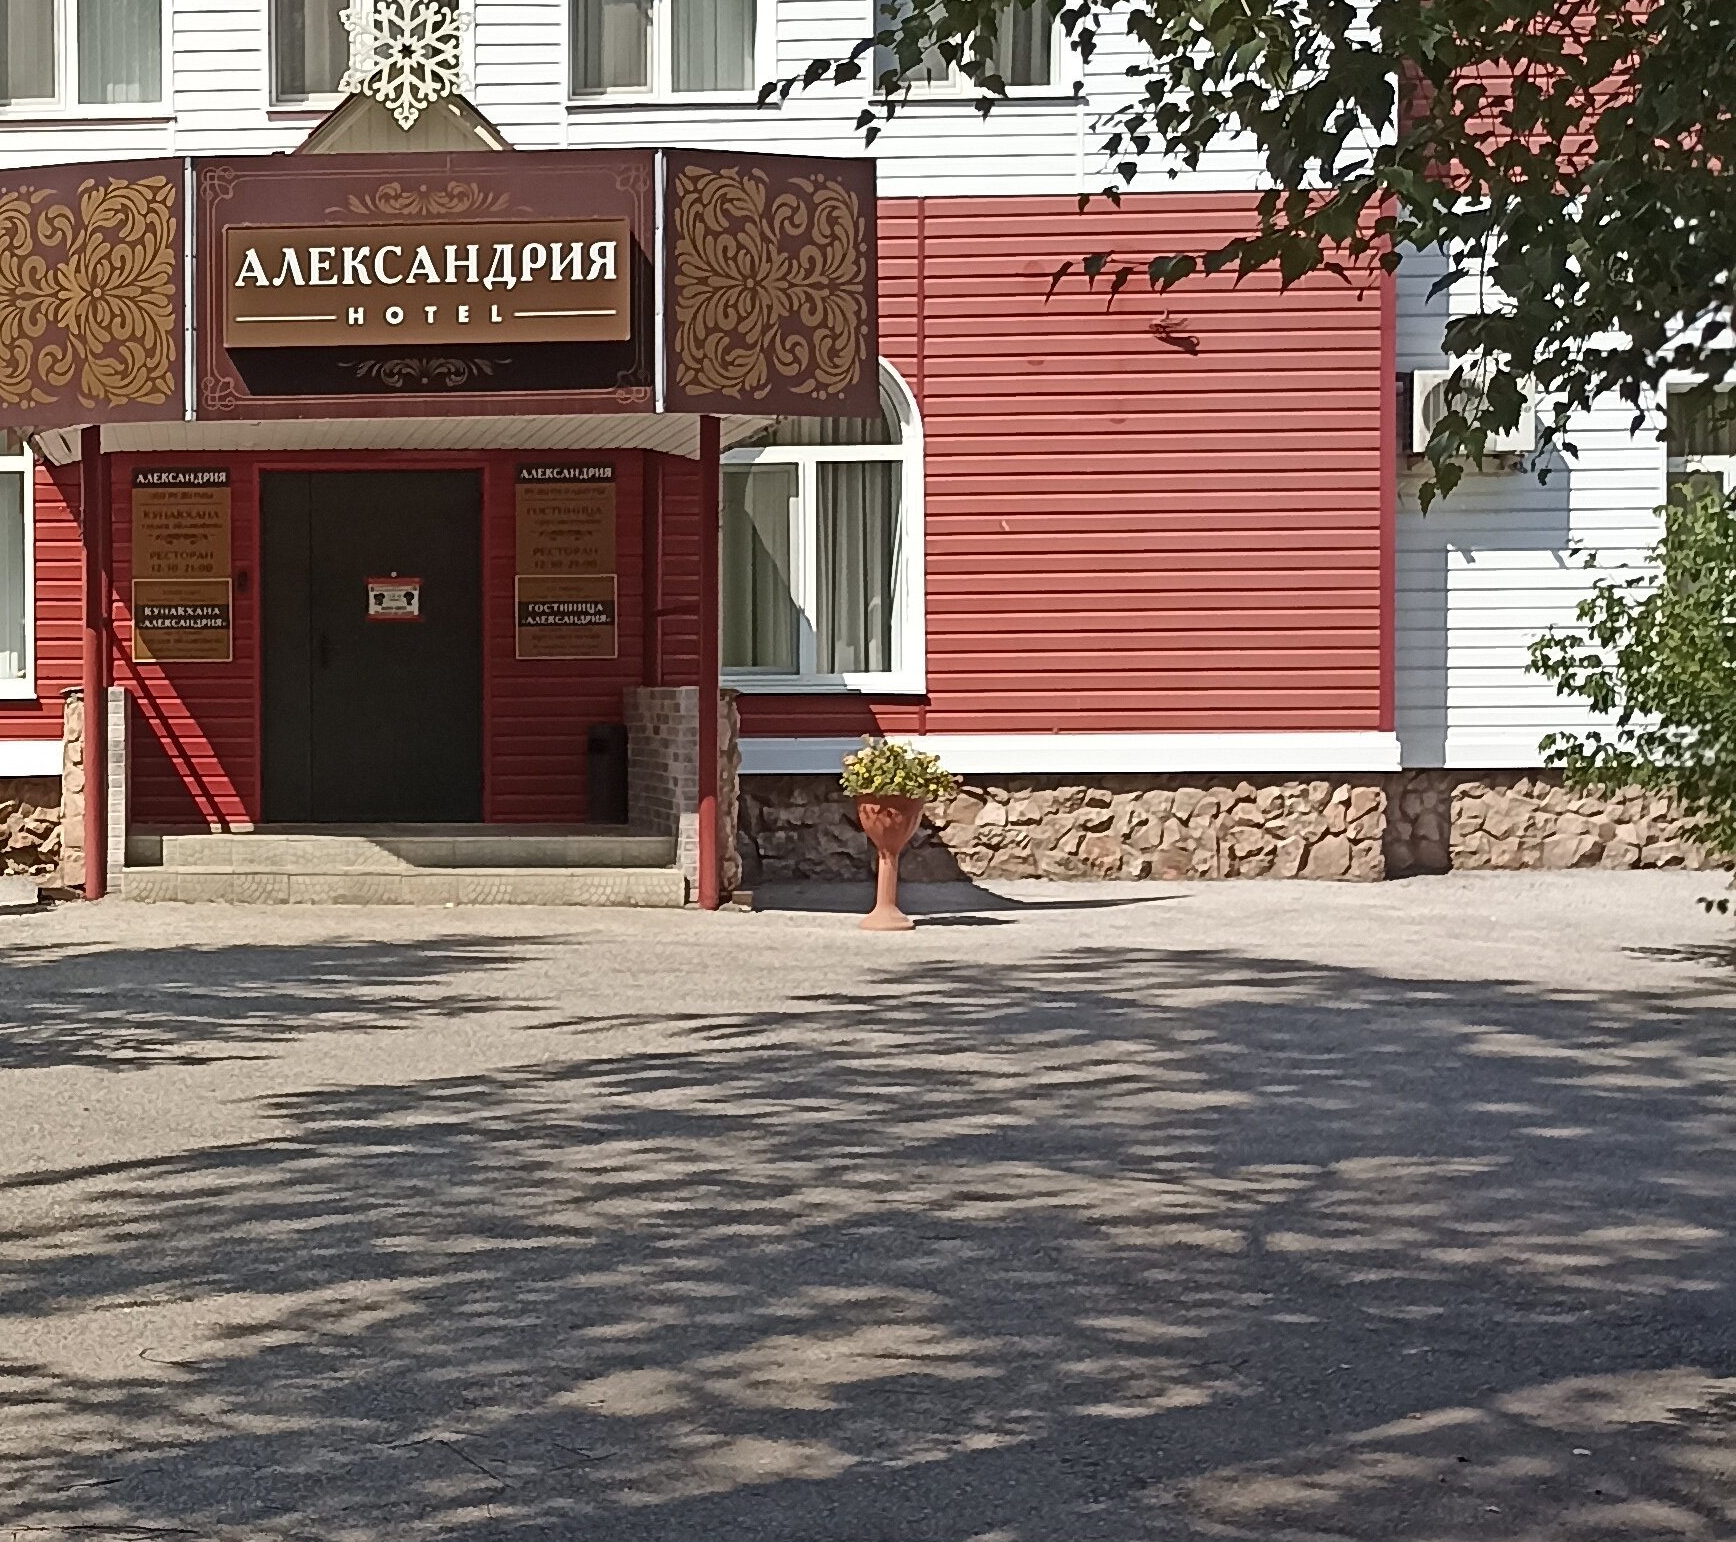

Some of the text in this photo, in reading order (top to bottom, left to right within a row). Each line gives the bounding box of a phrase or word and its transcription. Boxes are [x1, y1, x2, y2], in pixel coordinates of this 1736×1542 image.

[234, 241, 618, 290] АЛЕКСАНДРИЯ
[348, 304, 503, 325] HOTEL
[136, 472, 227, 484] АЛЕКСАНДРИЯ
[520, 467, 612, 480] АЛЕКСАНДРИЯ
[144, 607, 220, 616] КУНАКХАНА
[528, 603, 604, 614] ГОСТИНИЦА
